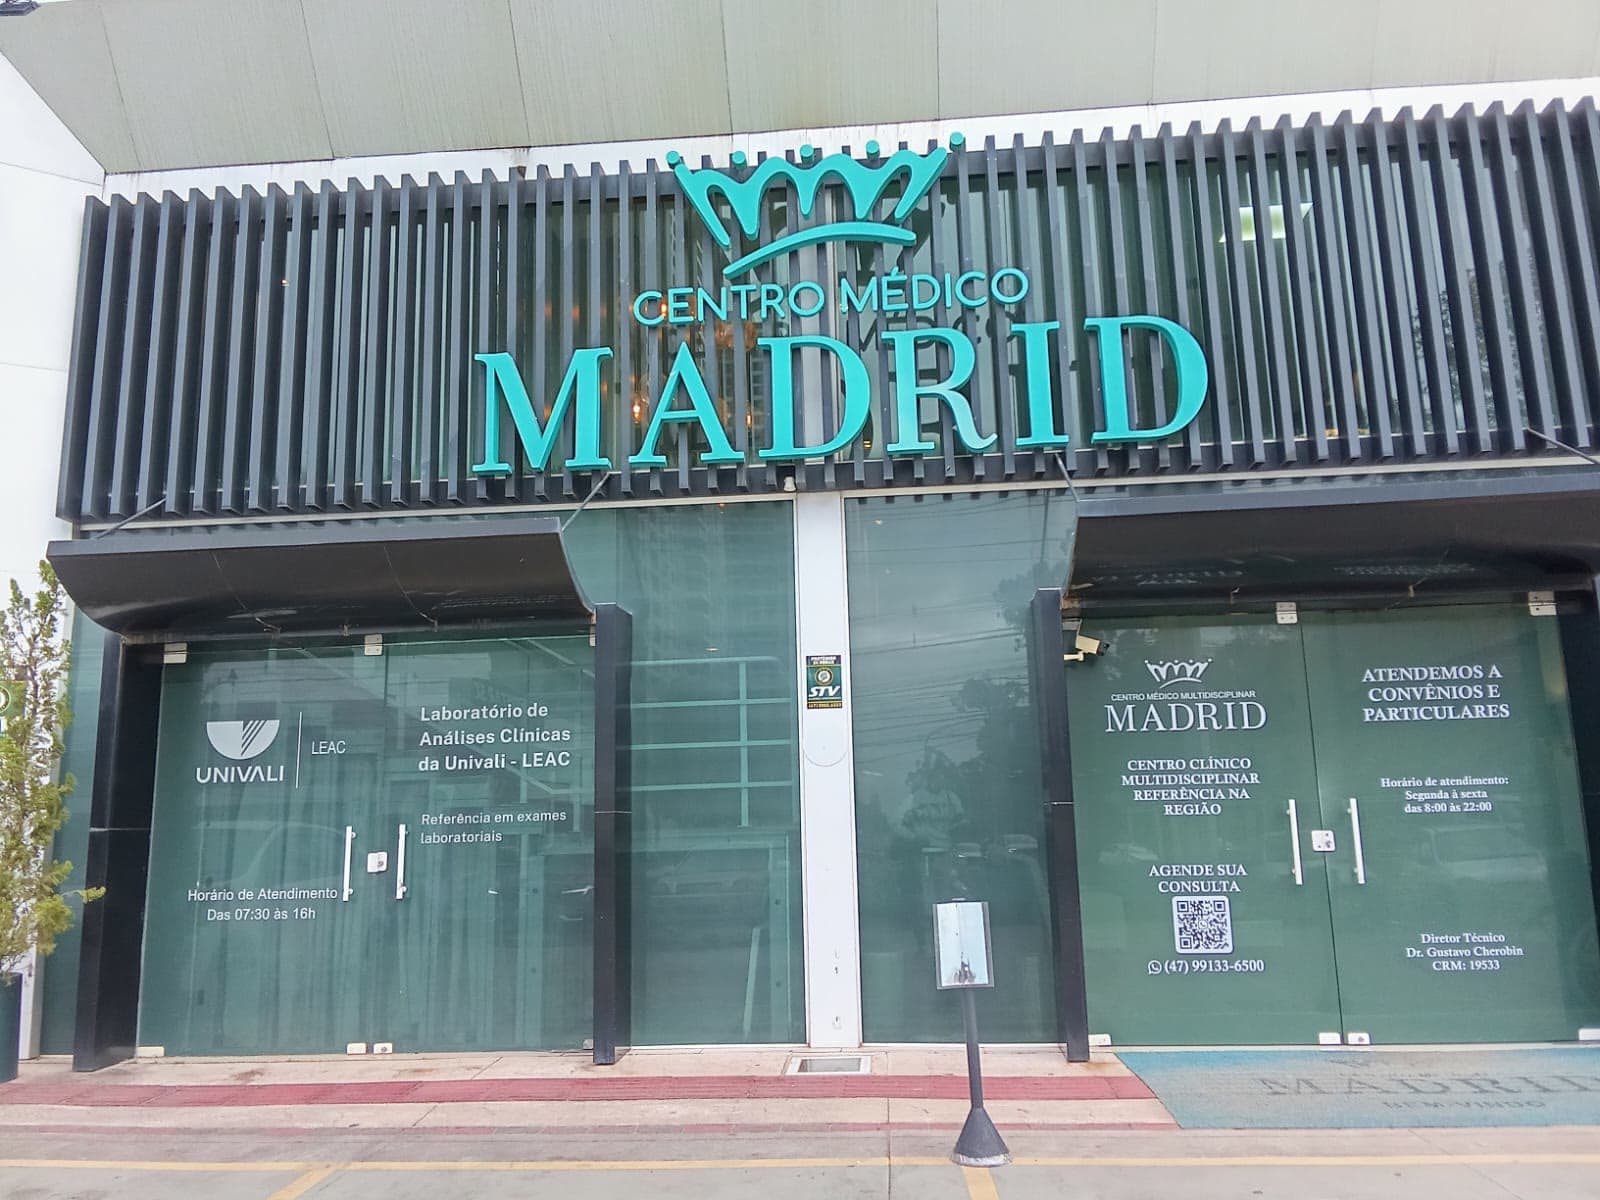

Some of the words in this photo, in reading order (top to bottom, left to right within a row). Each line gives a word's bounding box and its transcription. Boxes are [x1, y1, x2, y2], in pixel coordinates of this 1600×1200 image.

[632, 280, 825, 327] CENTRO
[840, 266, 1030, 314] MÉDICO
[471, 314, 1209, 476] MADRID
[1362, 665, 1484, 682] ATENDEMOS
[1488, 664, 1503, 679] A
[808, 685, 840, 698] STV
[1111, 693, 1145, 702] CENTRO
[1147, 691, 1179, 701] MÉDICO
[1181, 690, 1256, 700] MULTIDISCIPLINAR
[1368, 683, 1484, 702] CONVÊNIOS
[1488, 684, 1501, 698] E
[421, 704, 523, 722] Laboratório
[527, 703, 549, 718] de
[1104, 701, 1267, 732] MADRID
[1363, 704, 1510, 721] PARTICULARES
[419, 728, 496, 746] Análises
[500, 727, 571, 744] Clínicas
[311, 740, 346, 755] LEAC
[418, 755, 440, 771] da
[444, 753, 506, 771] Univali
[522, 752, 571, 769] LEAC
[1127, 759, 1186, 771] CENTRO
[1189, 756, 1251, 770] CLÍNICO
[196, 765, 284, 783] UNIVALI
[1121, 772, 1260, 786] MULTIDISCIPLINAR
[1381, 777, 1423, 787] Horário
[1425, 777, 1437, 786] de
[1440, 775, 1510, 786] atendimento:
[1133, 786, 1226, 801] REFERÊNCIA
[1229, 788, 1250, 799] NA
[1405, 790, 1449, 802] Segunda
[1460, 790, 1488, 799] sexta
[1164, 801, 1222, 816] REGIÃO
[1404, 803, 1422, 813] das
[1424, 802, 1448, 812] 8:00
[1463, 801, 1493, 812] 22:00
[421, 811, 490, 825] Referência
[494, 813, 513, 823] em
[517, 811, 567, 823] exames
[420, 830, 503, 844] laboratoriais
[1149, 864, 1215, 877] AGENDE
[1217, 864, 1248, 876] SUA
[188, 887, 234, 901] Horário
[238, 888, 254, 900] de
[258, 886, 338, 900] Atendimento
[1158, 880, 1240, 893] CONSULTA
[207, 908, 231, 921] Das
[234, 908, 270, 920] 07:30
[273, 907, 288, 920] às
[293, 908, 316, 920] 16h
[1421, 933, 1461, 944] Diretor
[1463, 932, 1506, 943] Técnico
[1406, 947, 1424, 958] Dr.
[1427, 946, 1471, 957] Gustavo
[1473, 945, 1524, 956] Cherobin
[1164, 960, 1190, 974] (47)
[1192, 959, 1265, 972] 99133-6500
[1432, 961, 1467, 971] CRM:
[1470, 960, 1500, 970] 19533
